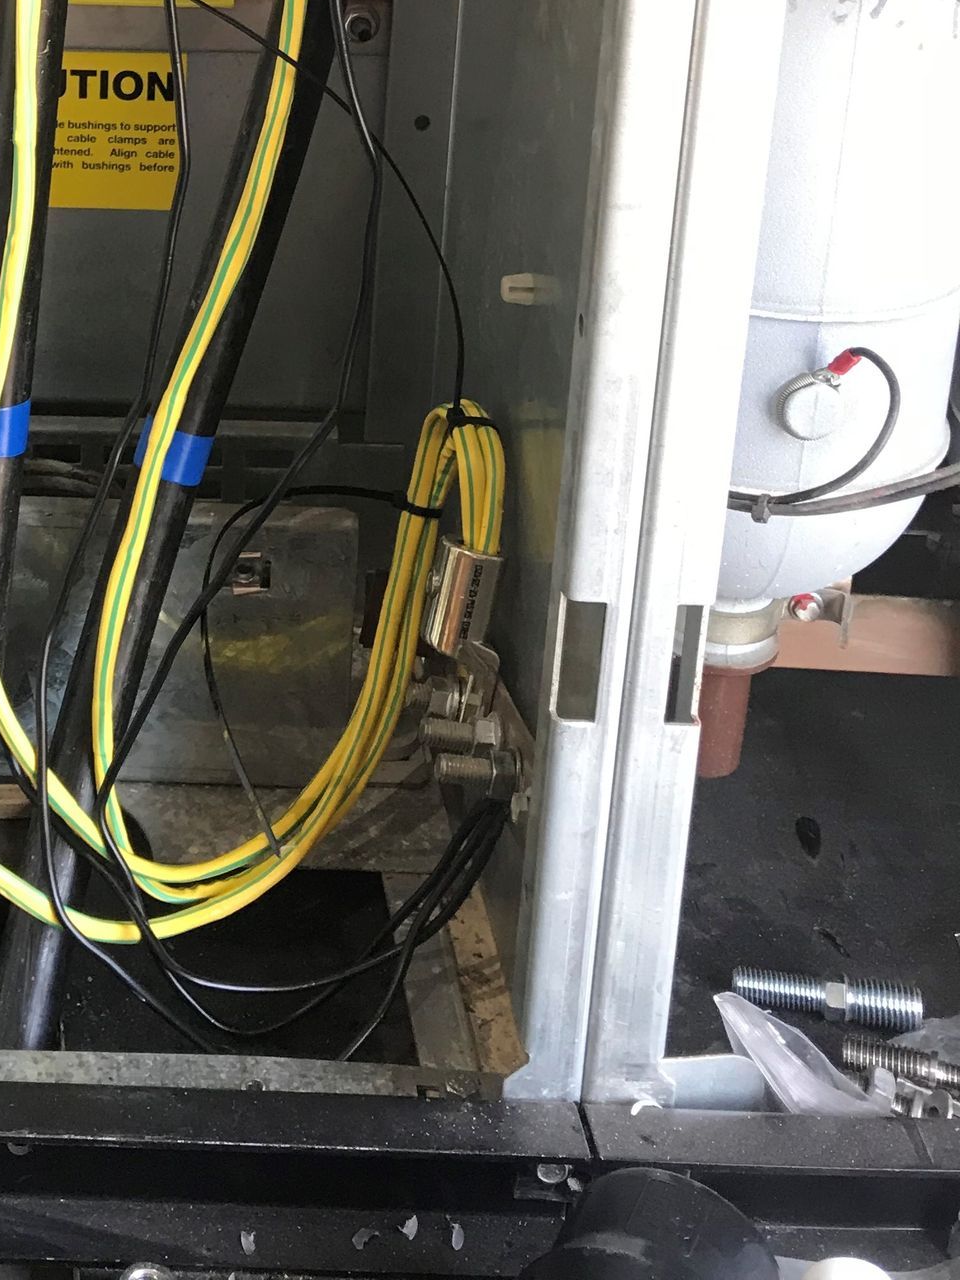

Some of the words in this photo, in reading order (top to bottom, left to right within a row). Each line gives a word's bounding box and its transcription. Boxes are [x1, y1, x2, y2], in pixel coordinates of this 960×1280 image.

[67, 120, 117, 132] bushings
[120, 123, 131, 131] to
[133, 123, 176, 133] support
[67, 134, 97, 143] cable
[107, 135, 148, 146] clamps
[158, 138, 176, 146] are
[109, 148, 138, 159] Align
[145, 150, 175, 159] cable
[52, 161, 74, 169] with
[81, 161, 132, 173] bushings
[139, 162, 175, 173] before
